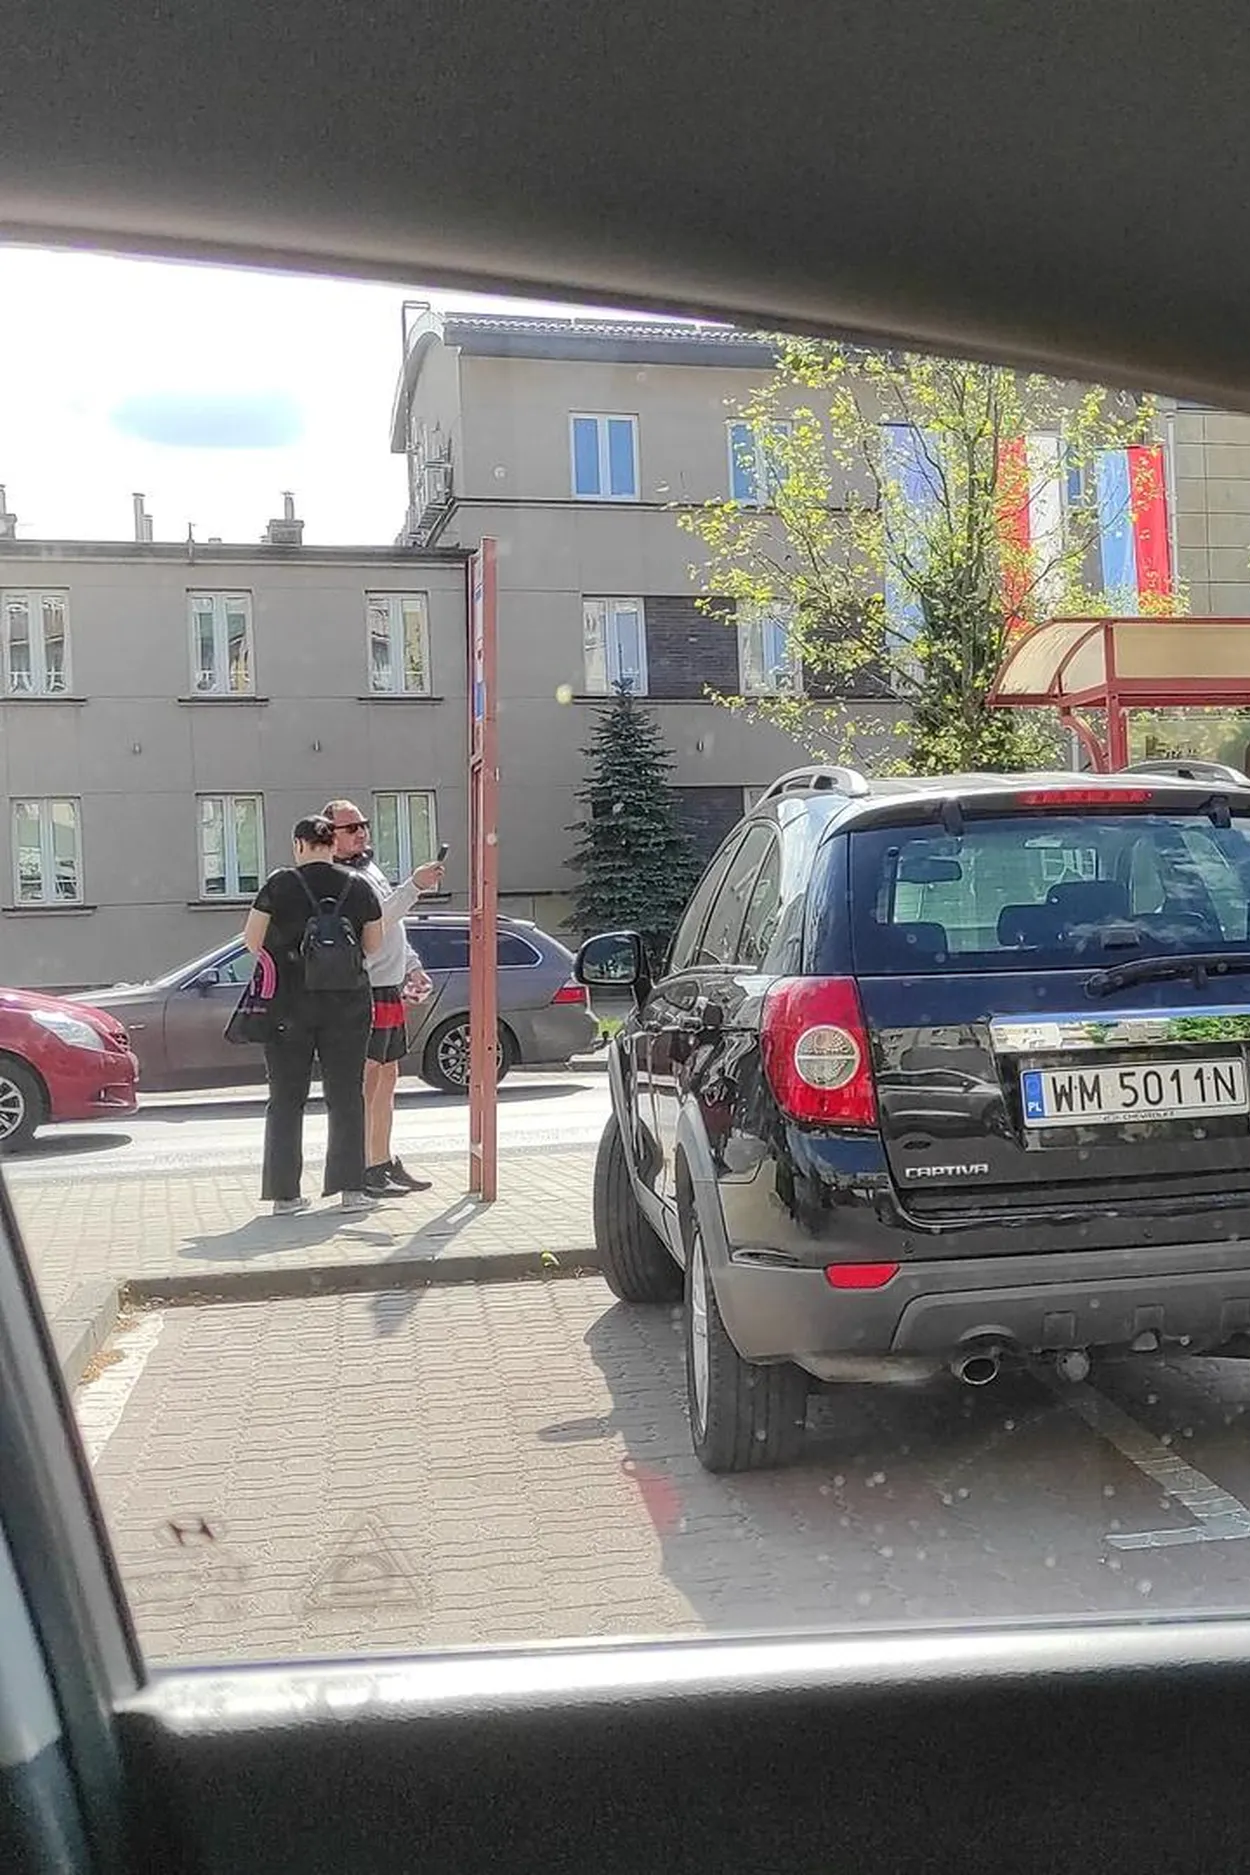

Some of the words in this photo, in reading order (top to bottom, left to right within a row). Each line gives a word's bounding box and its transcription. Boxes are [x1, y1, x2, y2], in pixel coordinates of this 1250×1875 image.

[1052, 1074, 1102, 1112] WM
[1119, 1066, 1236, 1108] 5011N
[1028, 1101, 1042, 1112] PL
[905, 1164, 989, 1178] CAPTIVA
